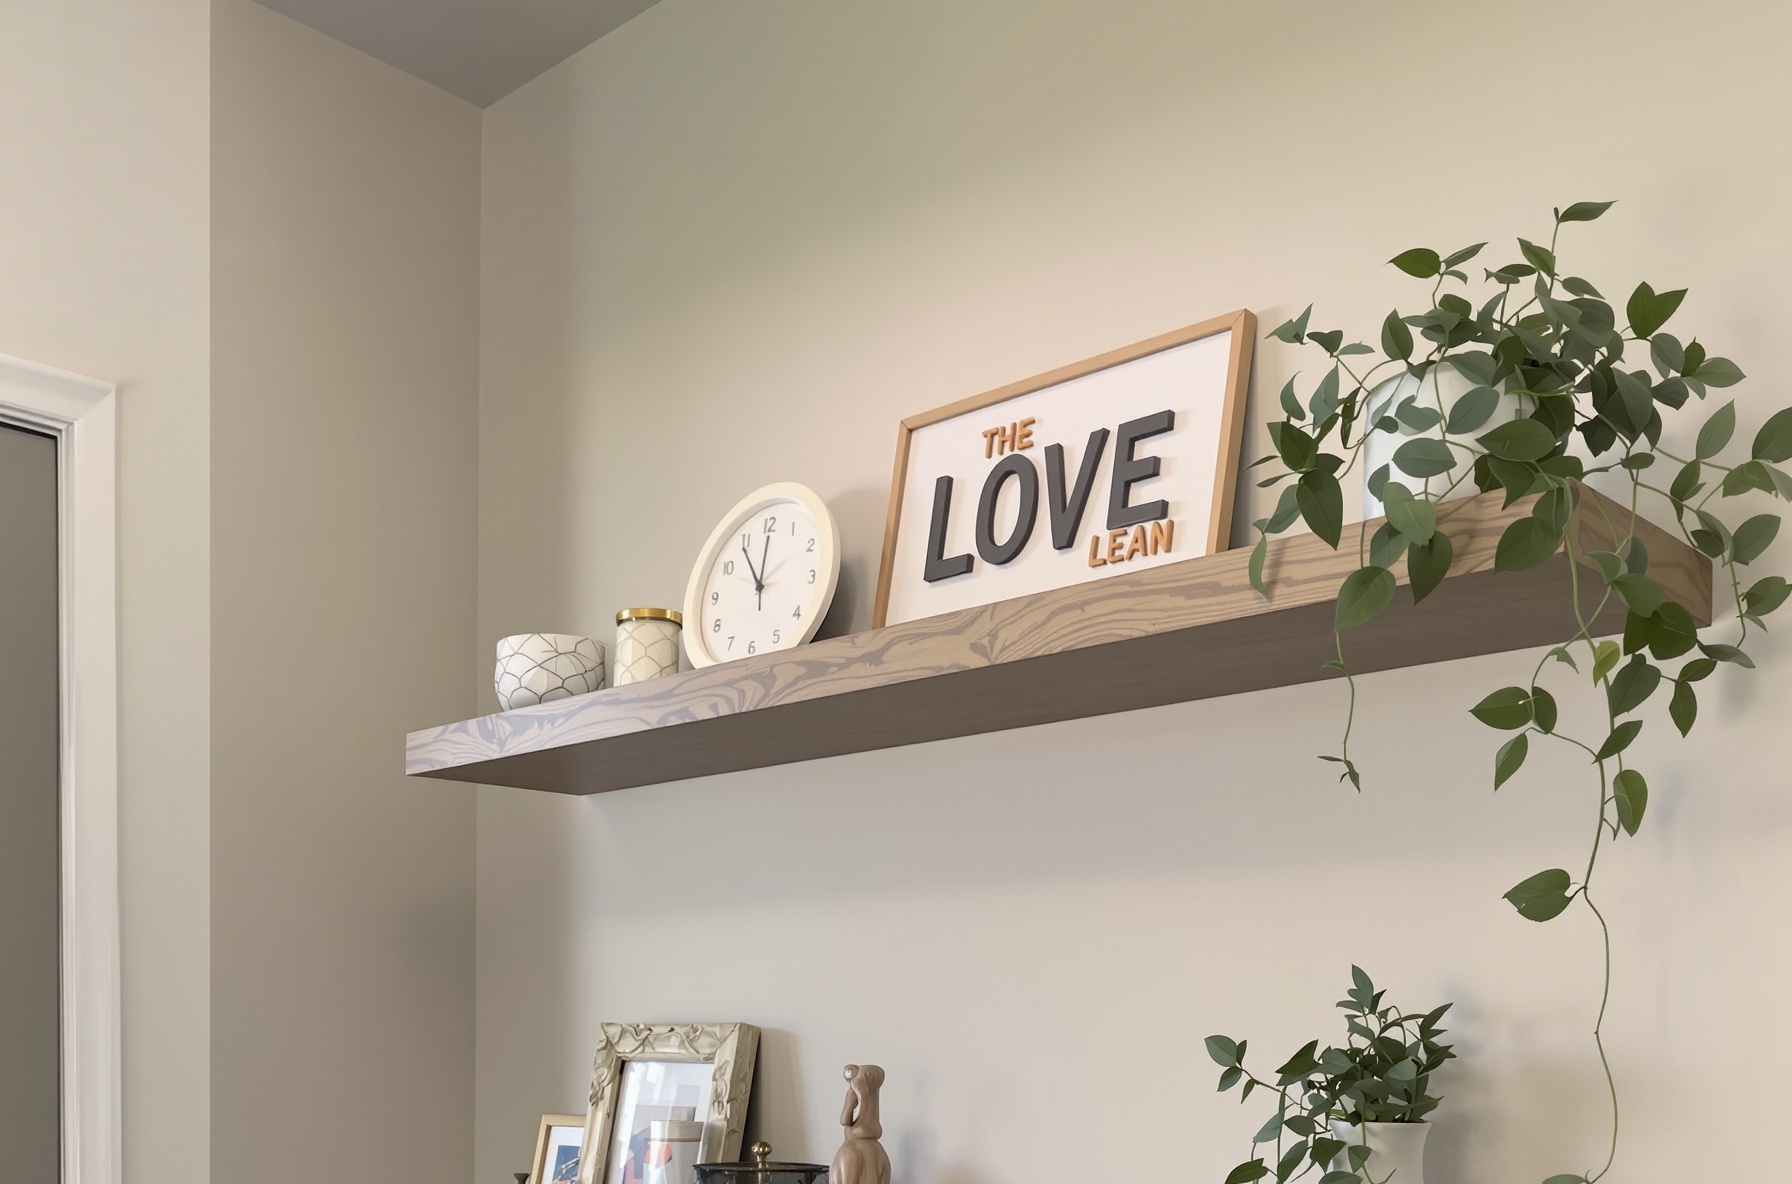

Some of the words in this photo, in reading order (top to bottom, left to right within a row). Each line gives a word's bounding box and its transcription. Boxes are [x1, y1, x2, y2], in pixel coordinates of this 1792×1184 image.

[981, 416, 1036, 459] THE
[923, 409, 1176, 583] LOVE
[763, 516, 776, 534] 12
[742, 533, 751, 548] 11
[805, 538, 815, 552] 2
[1088, 519, 1175, 568] LEAN
[723, 560, 734, 576] 10
[807, 569, 816, 584] 3
[711, 591, 719, 606] 9
[792, 604, 801, 620] 4
[713, 618, 721, 633] 8
[727, 635, 735, 651] 7
[772, 629, 780, 644] 5
[748, 640, 756, 655] 6
